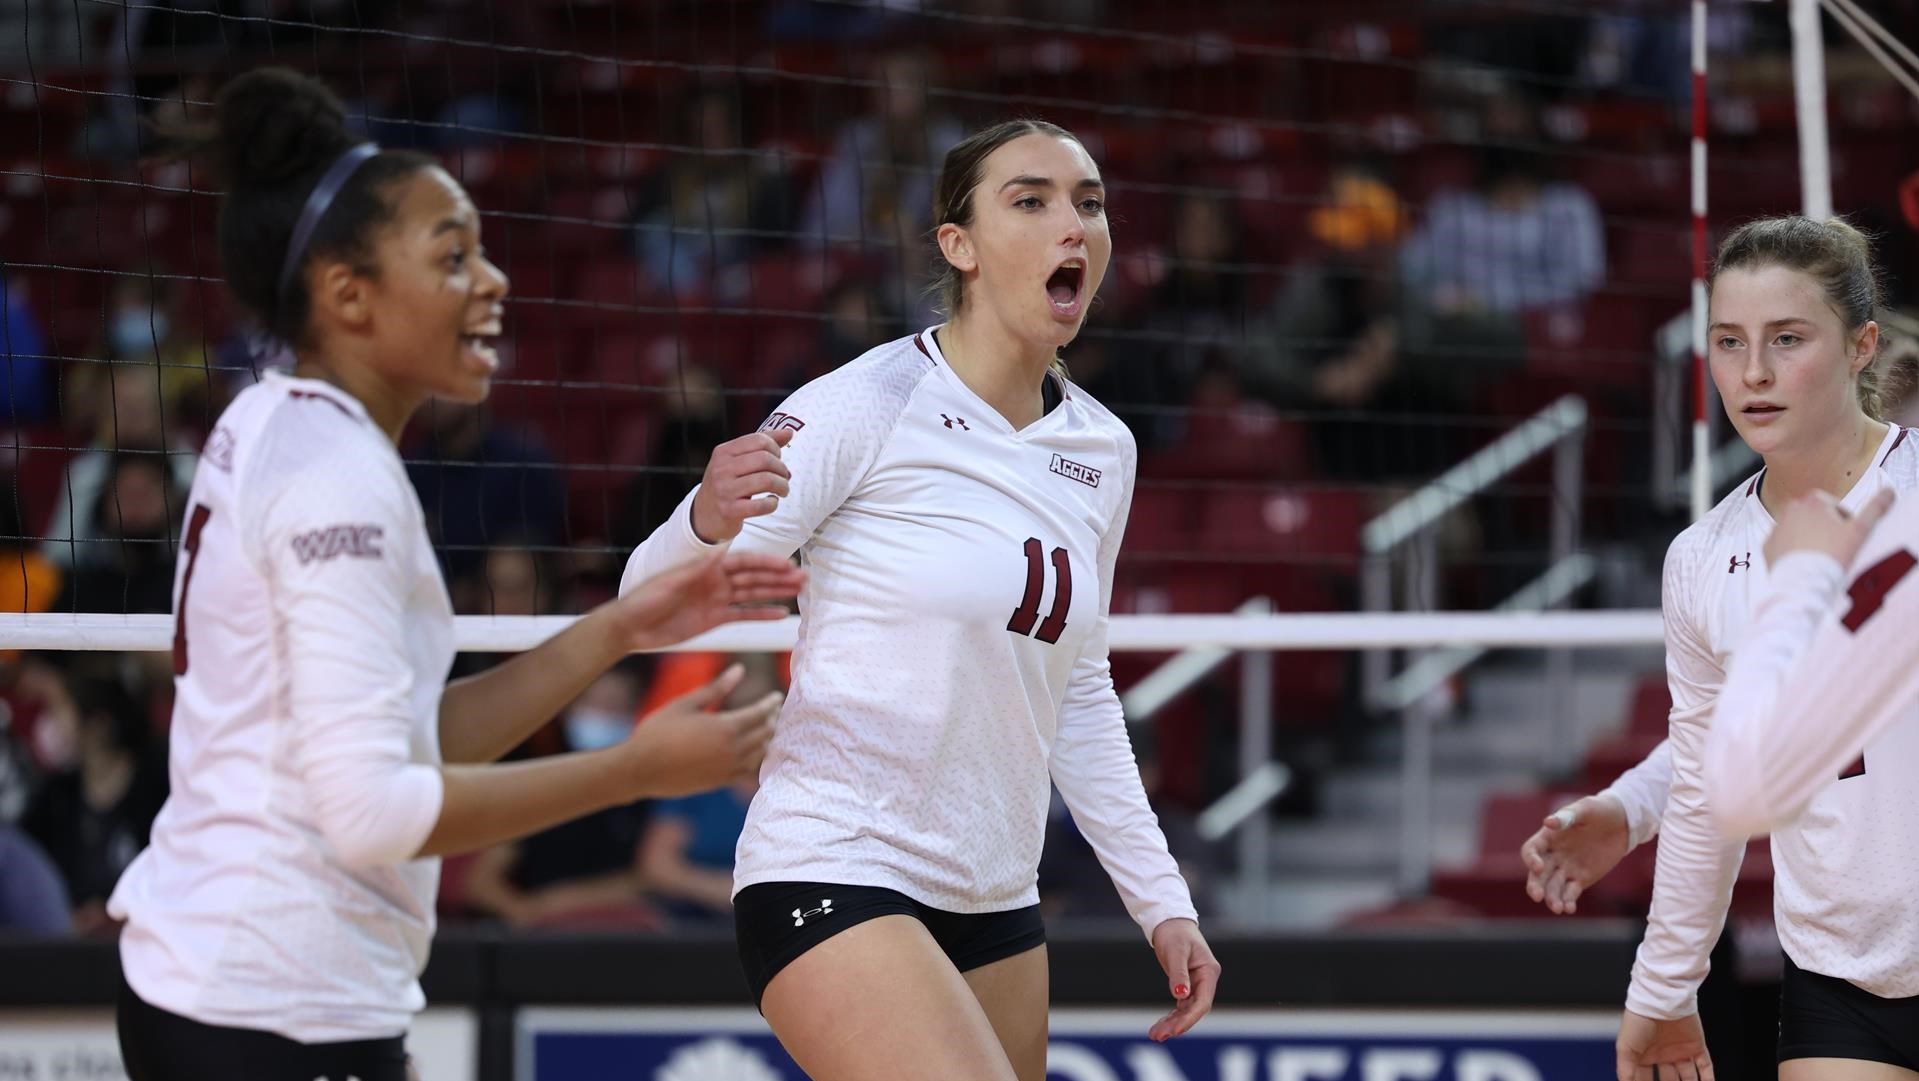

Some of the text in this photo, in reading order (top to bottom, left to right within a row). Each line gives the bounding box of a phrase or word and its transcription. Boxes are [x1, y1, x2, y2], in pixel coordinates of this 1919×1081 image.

[757, 412, 806, 432] AC
[1049, 453, 1102, 488] AGGIES
[290, 523, 384, 566] WAC
[1006, 536, 1072, 645] 11
